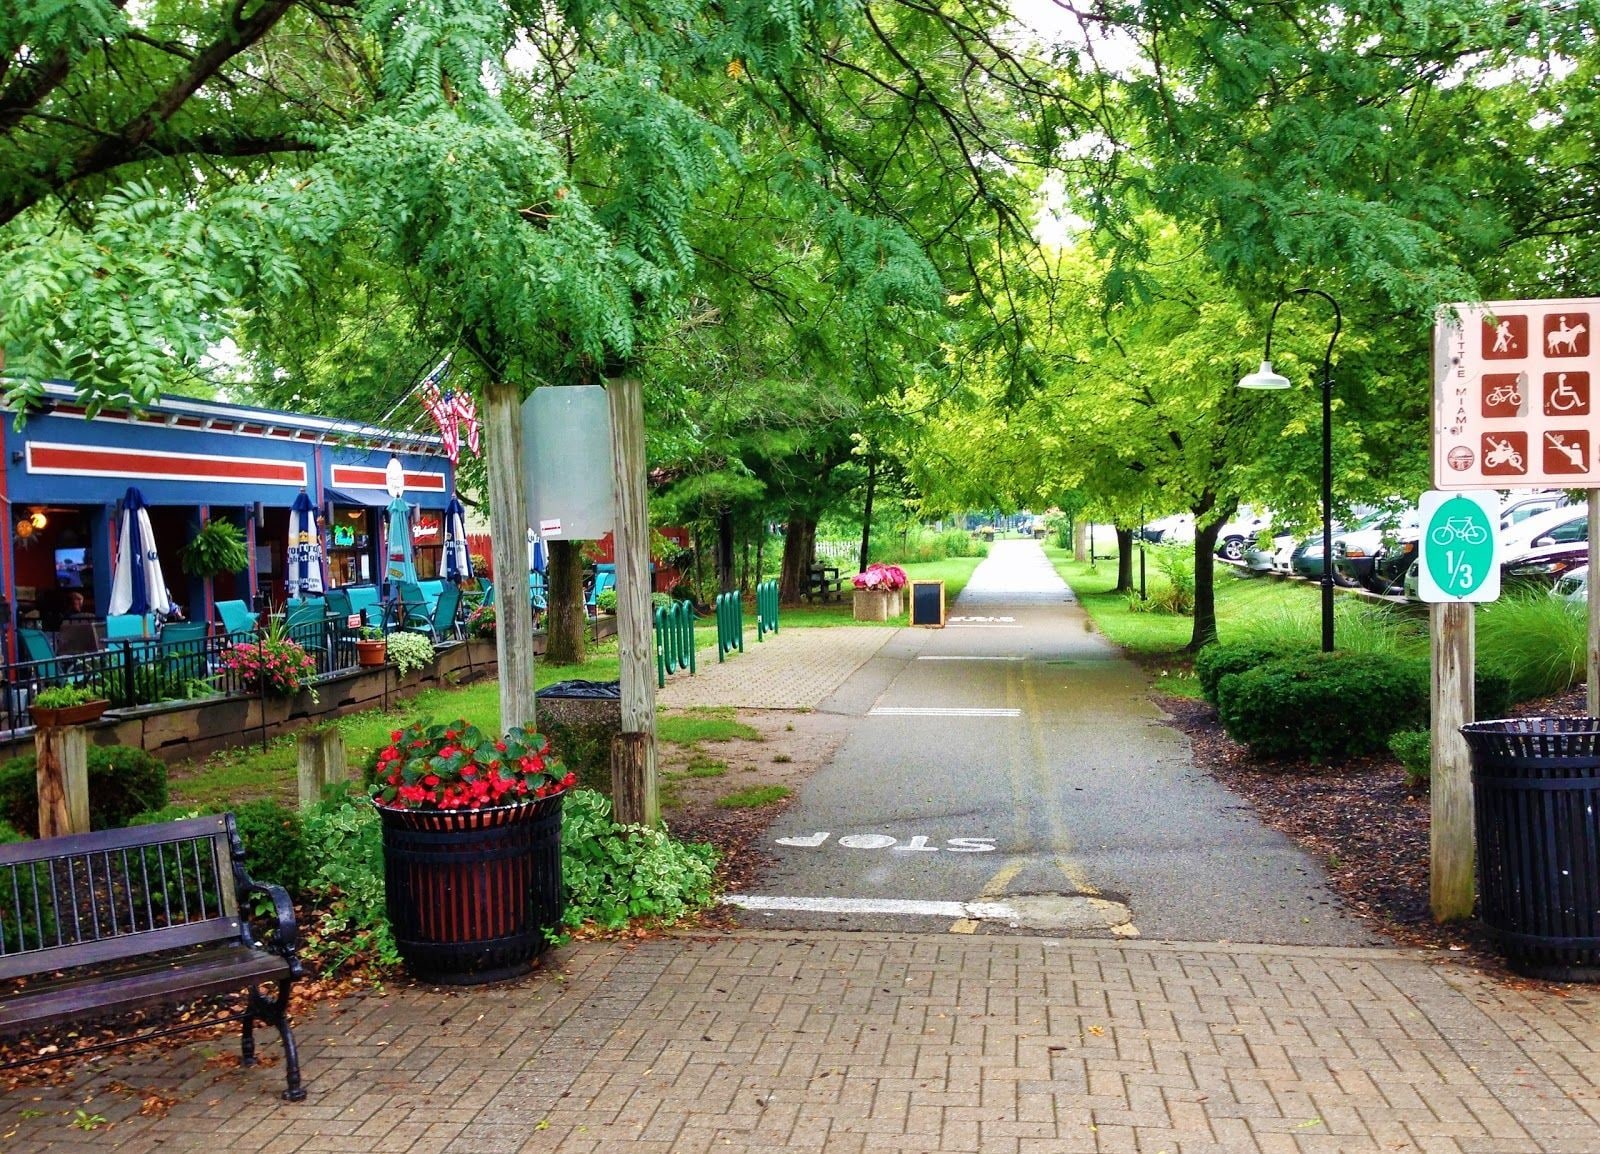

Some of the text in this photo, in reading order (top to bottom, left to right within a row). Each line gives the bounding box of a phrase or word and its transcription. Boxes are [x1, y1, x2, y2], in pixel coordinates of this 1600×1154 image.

[1456, 388, 1467, 433] MIAMI
[1446, 550, 1473, 589] 1/3
[774, 832, 996, 852] STOP
